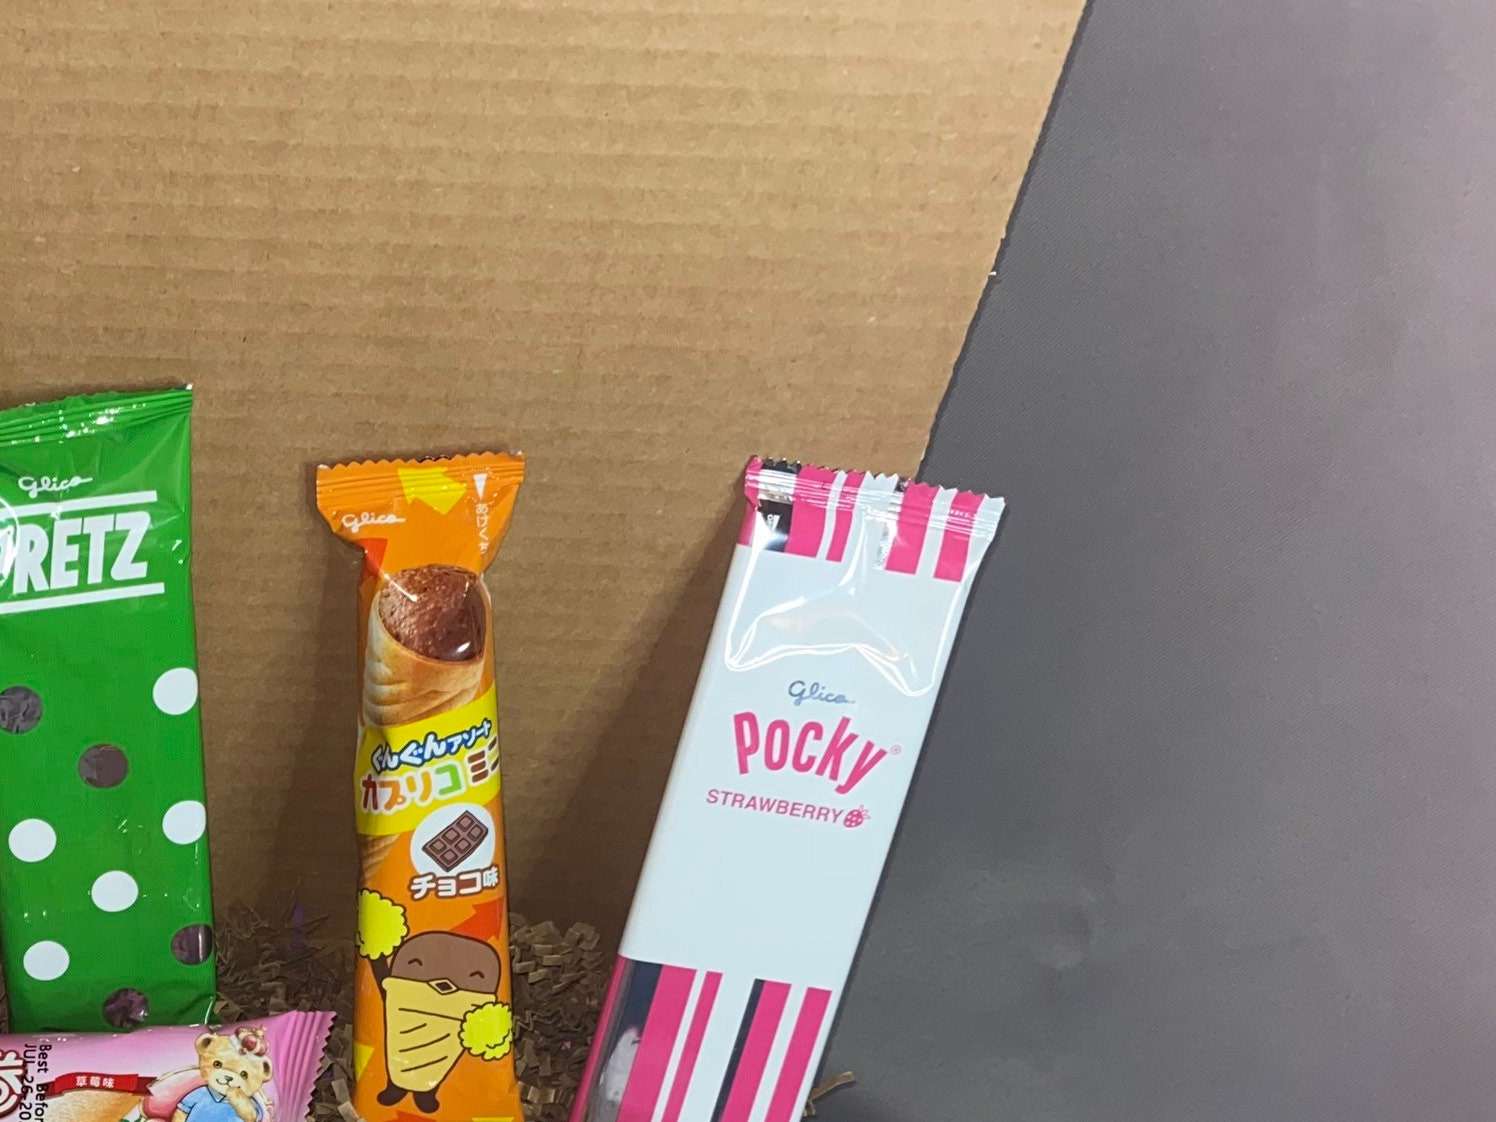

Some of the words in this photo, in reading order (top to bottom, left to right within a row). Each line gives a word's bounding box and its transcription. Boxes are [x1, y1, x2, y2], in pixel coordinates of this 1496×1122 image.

[706, 789, 844, 824] STRAWBERRY
[410, 865, 500, 900] チョコ味
[37, 1043, 53, 1074] Best
[75, 1075, 115, 1089] 草莓味
